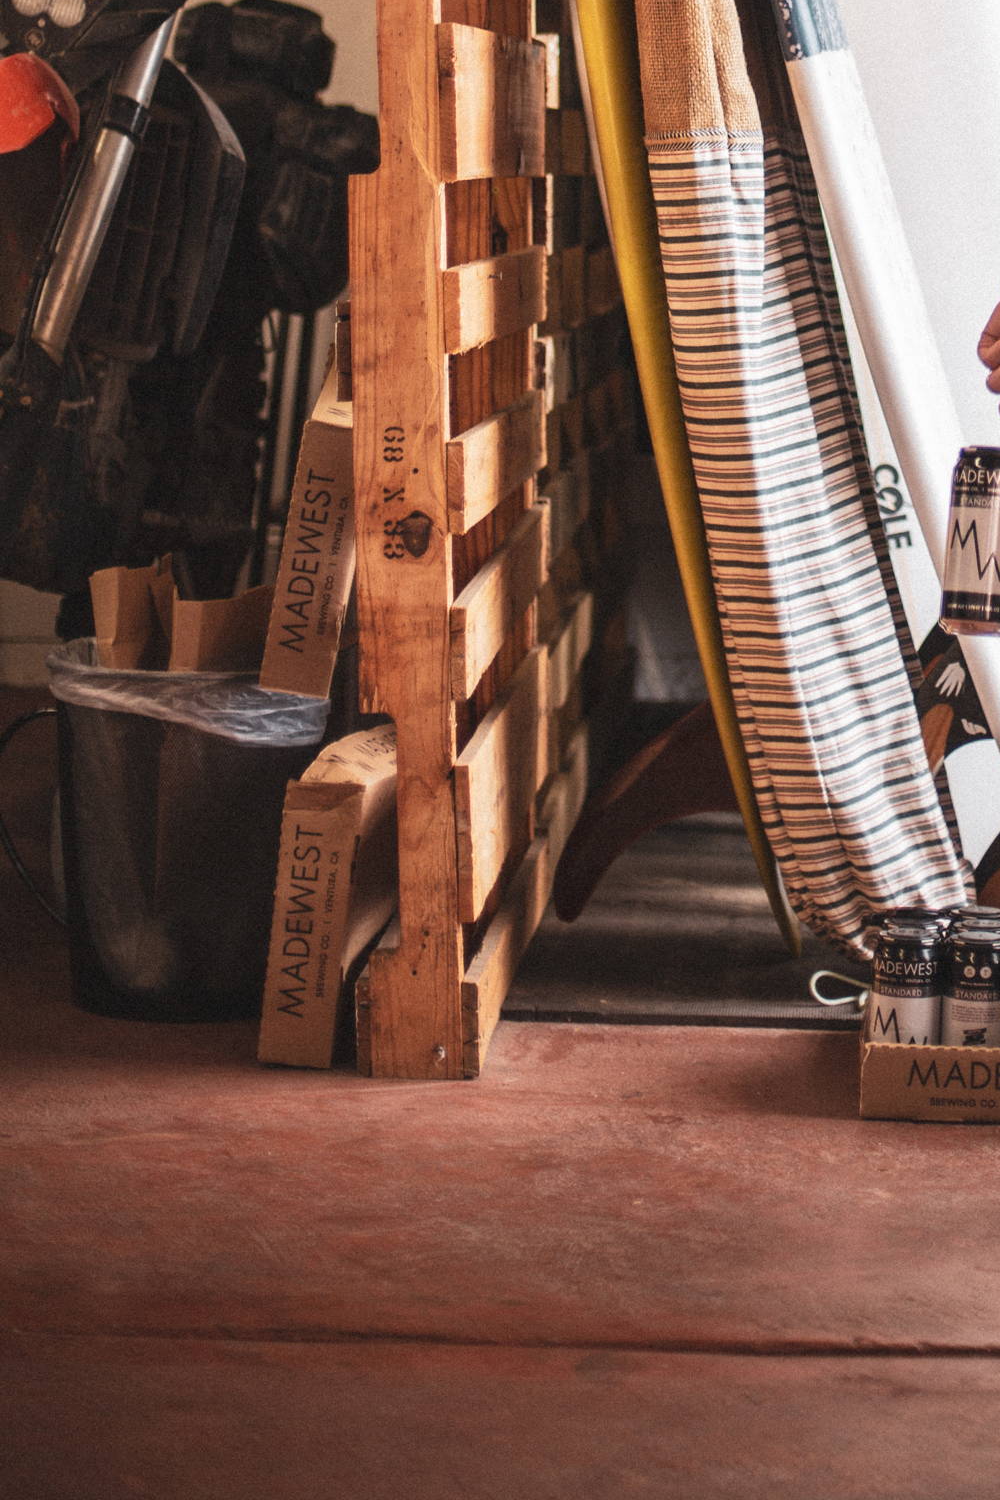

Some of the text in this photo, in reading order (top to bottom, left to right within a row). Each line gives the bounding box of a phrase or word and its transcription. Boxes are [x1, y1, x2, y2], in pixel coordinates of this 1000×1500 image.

[874, 464, 912, 549] COLE
[278, 468, 336, 653] MADEWEST
[277, 824, 323, 1018] MADEWEST
[873, 959, 937, 976] MADEWEST
[880, 987, 922, 997] STANDARD
[929, 1097, 977, 1108] BREWING
[980, 1099, 998, 1109] CO.
